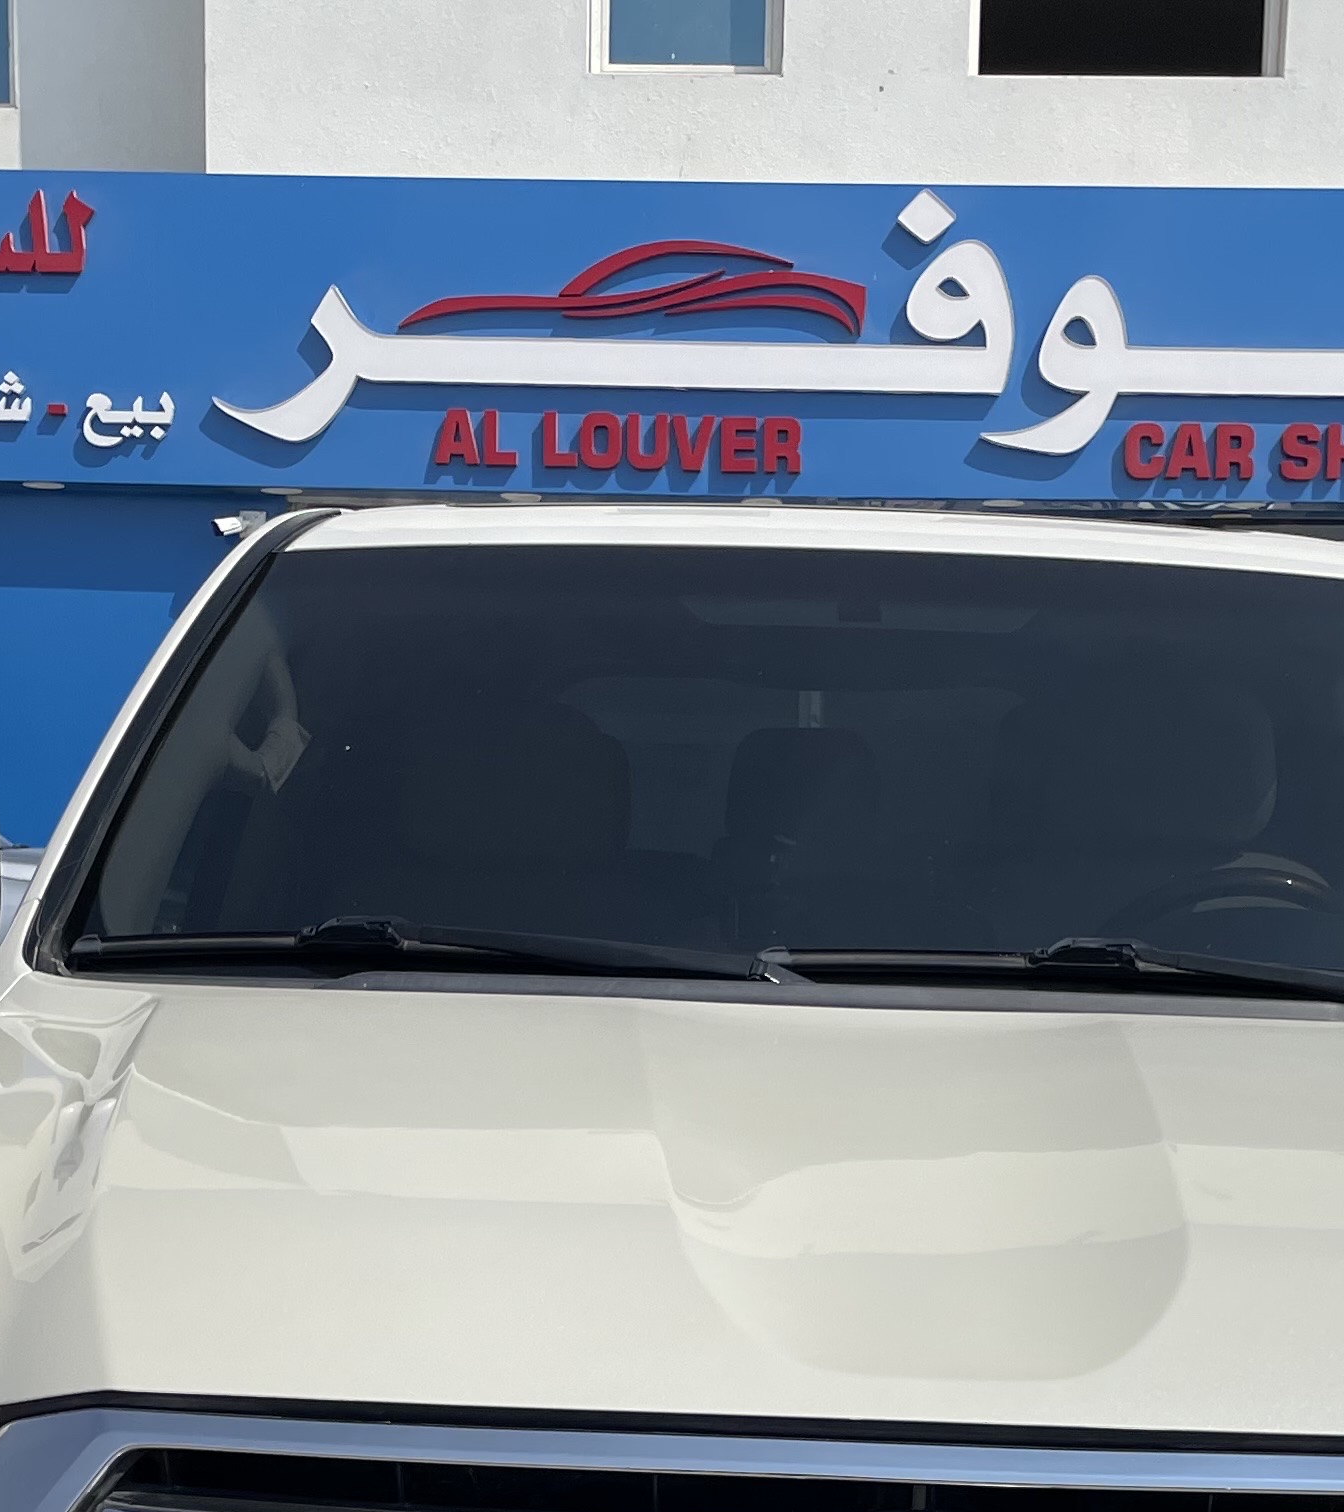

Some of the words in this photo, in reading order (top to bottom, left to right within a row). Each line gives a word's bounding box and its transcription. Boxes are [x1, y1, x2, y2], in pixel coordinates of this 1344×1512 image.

[82, 391, 174, 447] بيع
[434, 408, 519, 467] AL
[542, 411, 802, 474] LOUVER
[1123, 422, 1255, 482] CAR
